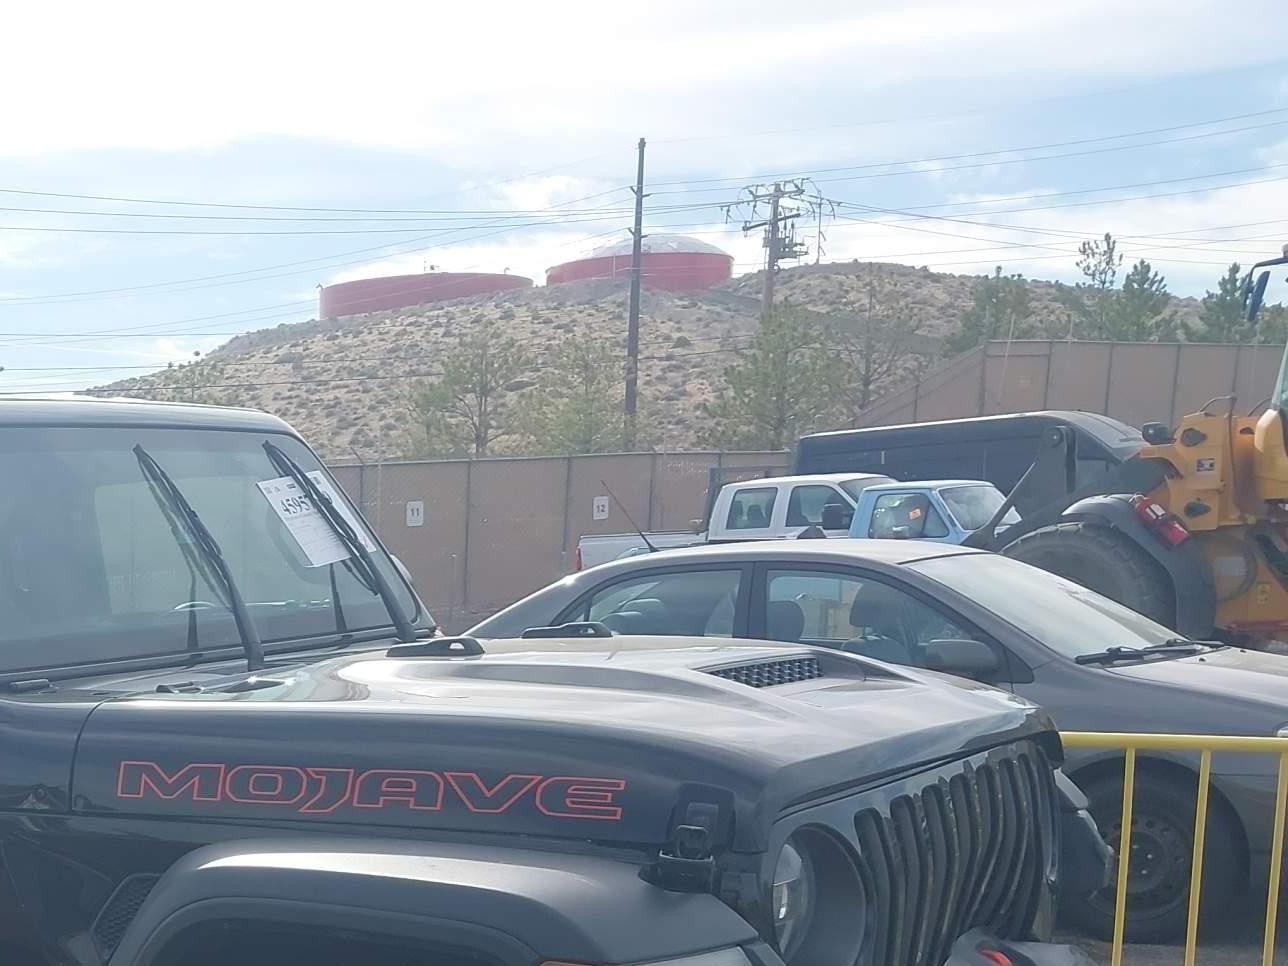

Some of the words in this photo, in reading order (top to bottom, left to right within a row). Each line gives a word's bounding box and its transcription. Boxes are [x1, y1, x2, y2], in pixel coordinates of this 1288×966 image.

[410, 507, 420, 516] 11
[596, 504, 606, 513] 12
[117, 760, 626, 820] MOJAVE
